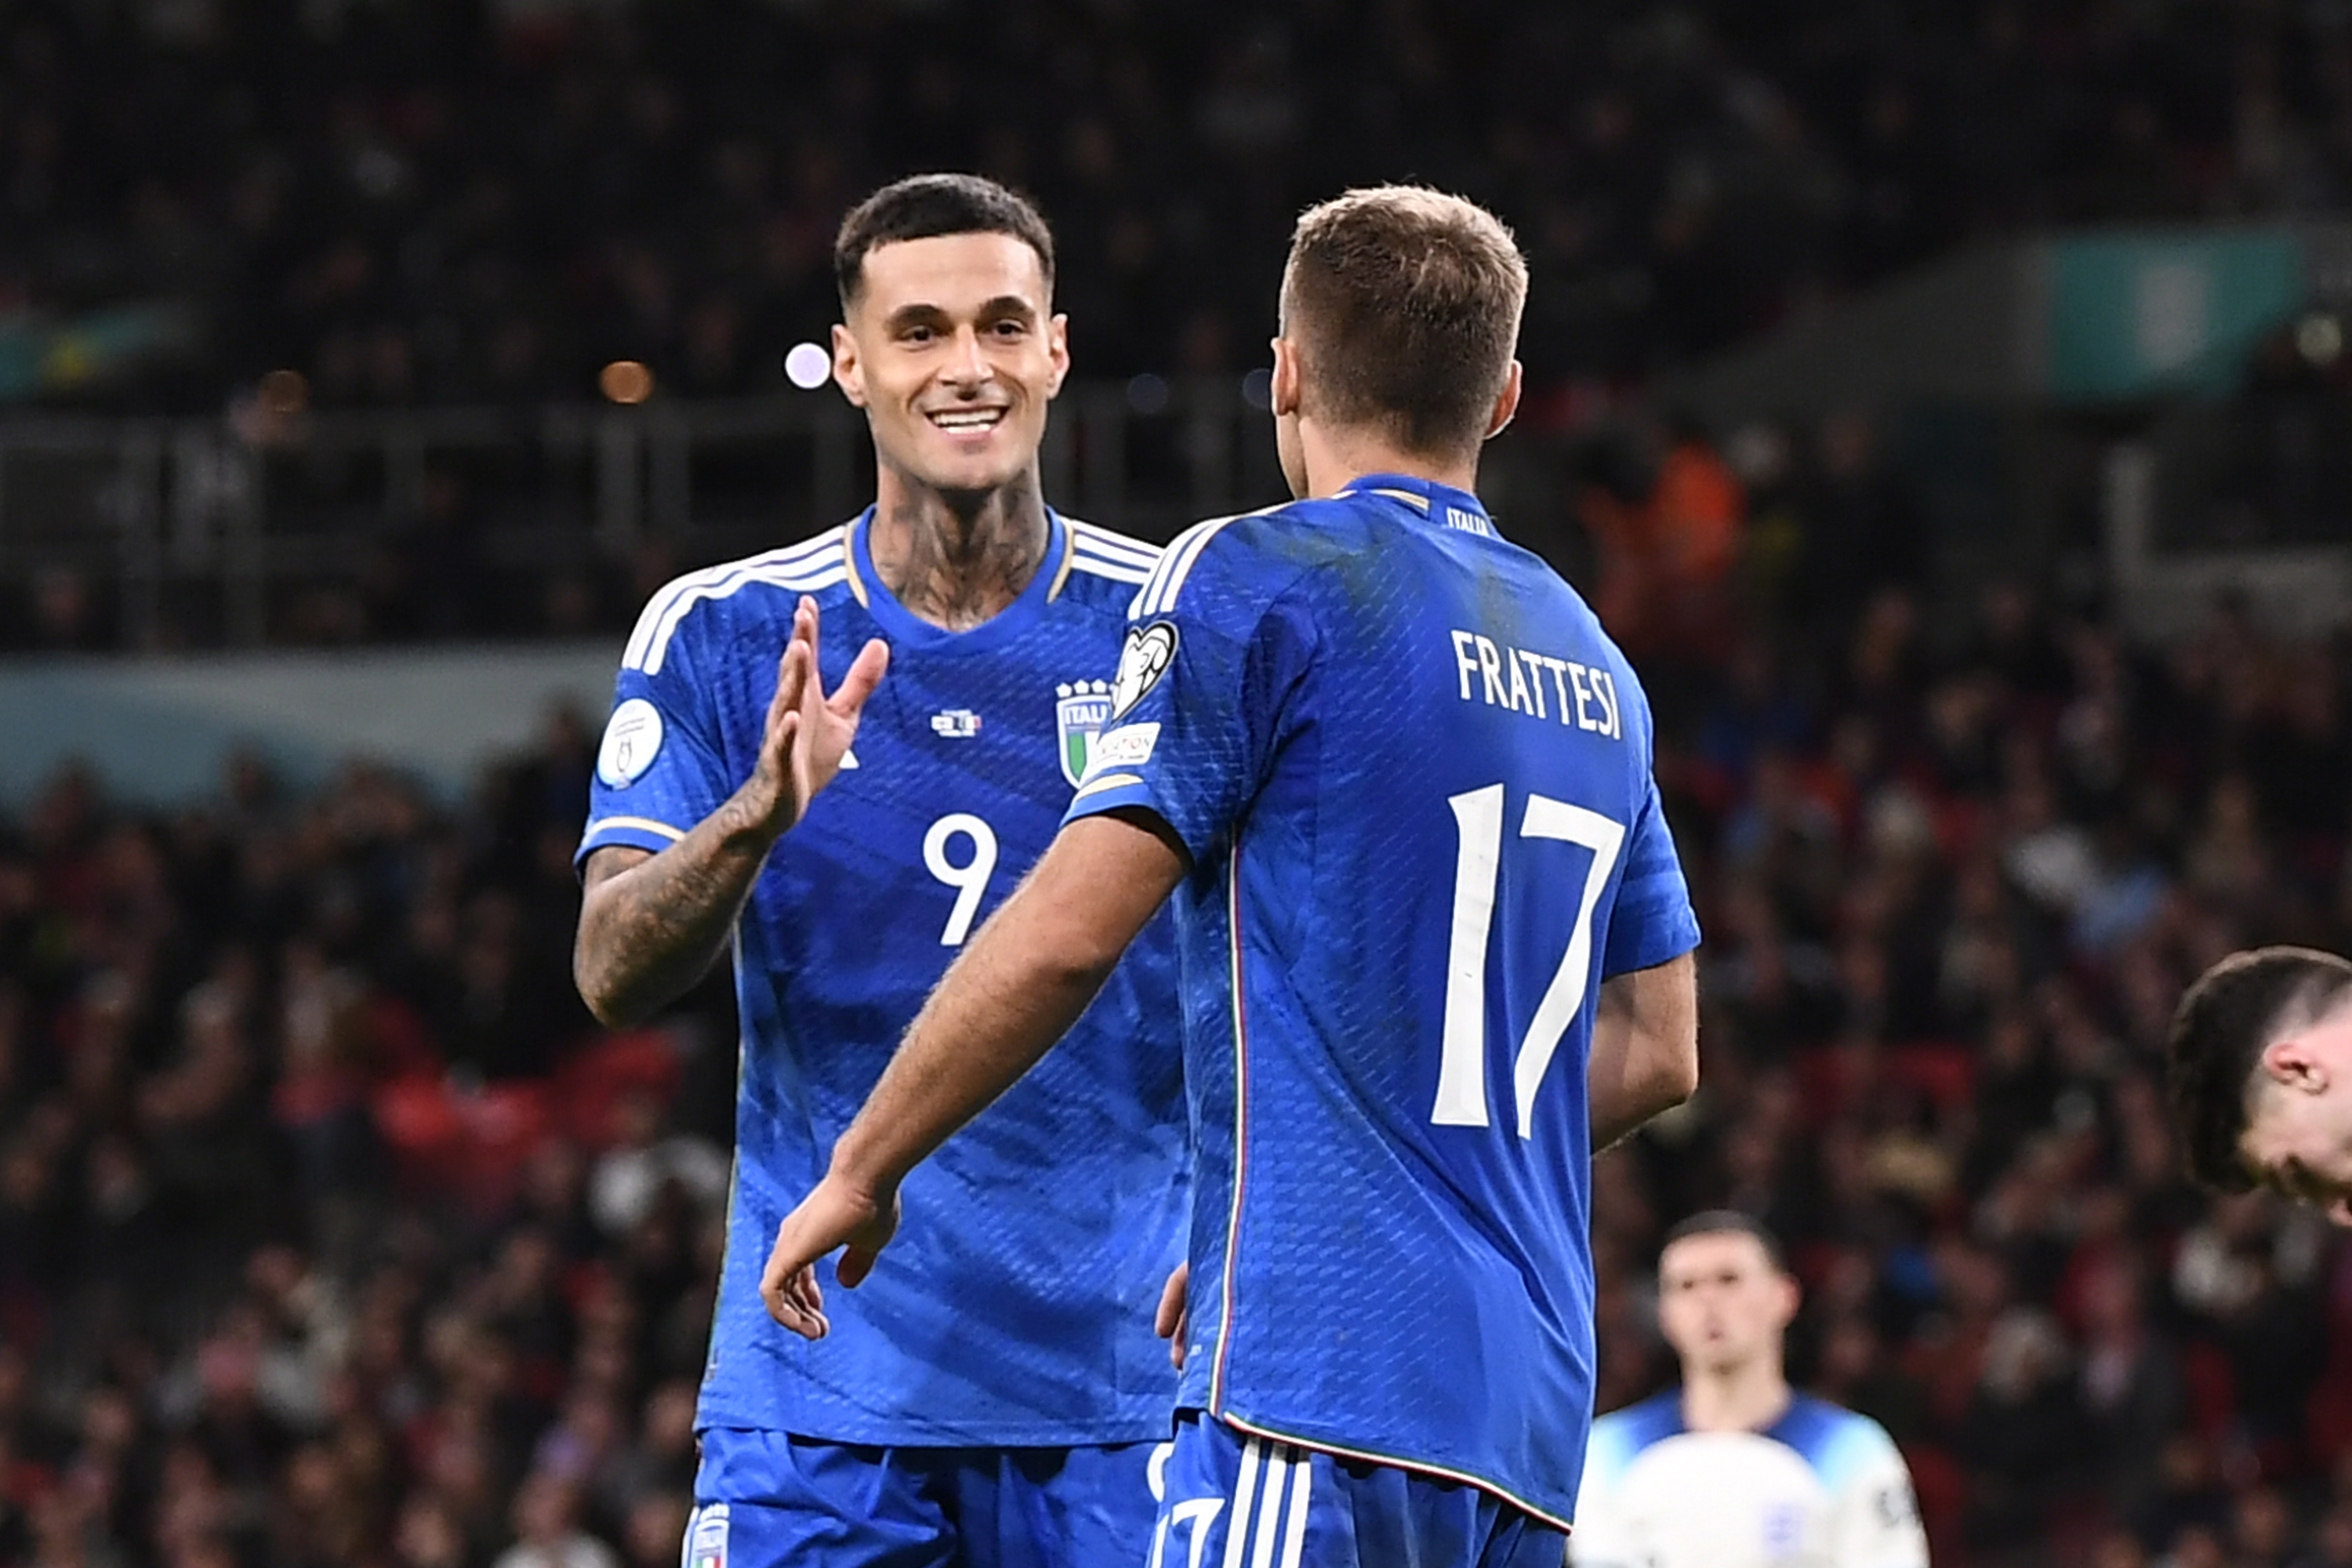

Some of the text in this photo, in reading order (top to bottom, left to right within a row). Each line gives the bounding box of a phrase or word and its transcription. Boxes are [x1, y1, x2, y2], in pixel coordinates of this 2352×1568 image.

[1447, 506, 1489, 537] ITALIA
[1065, 704, 1108, 725] ITALI
[1450, 630, 1621, 741] FRATTESI
[923, 813, 998, 946] 9
[1430, 782, 1626, 1141] 17
[1151, 1498, 1225, 1568] 17
